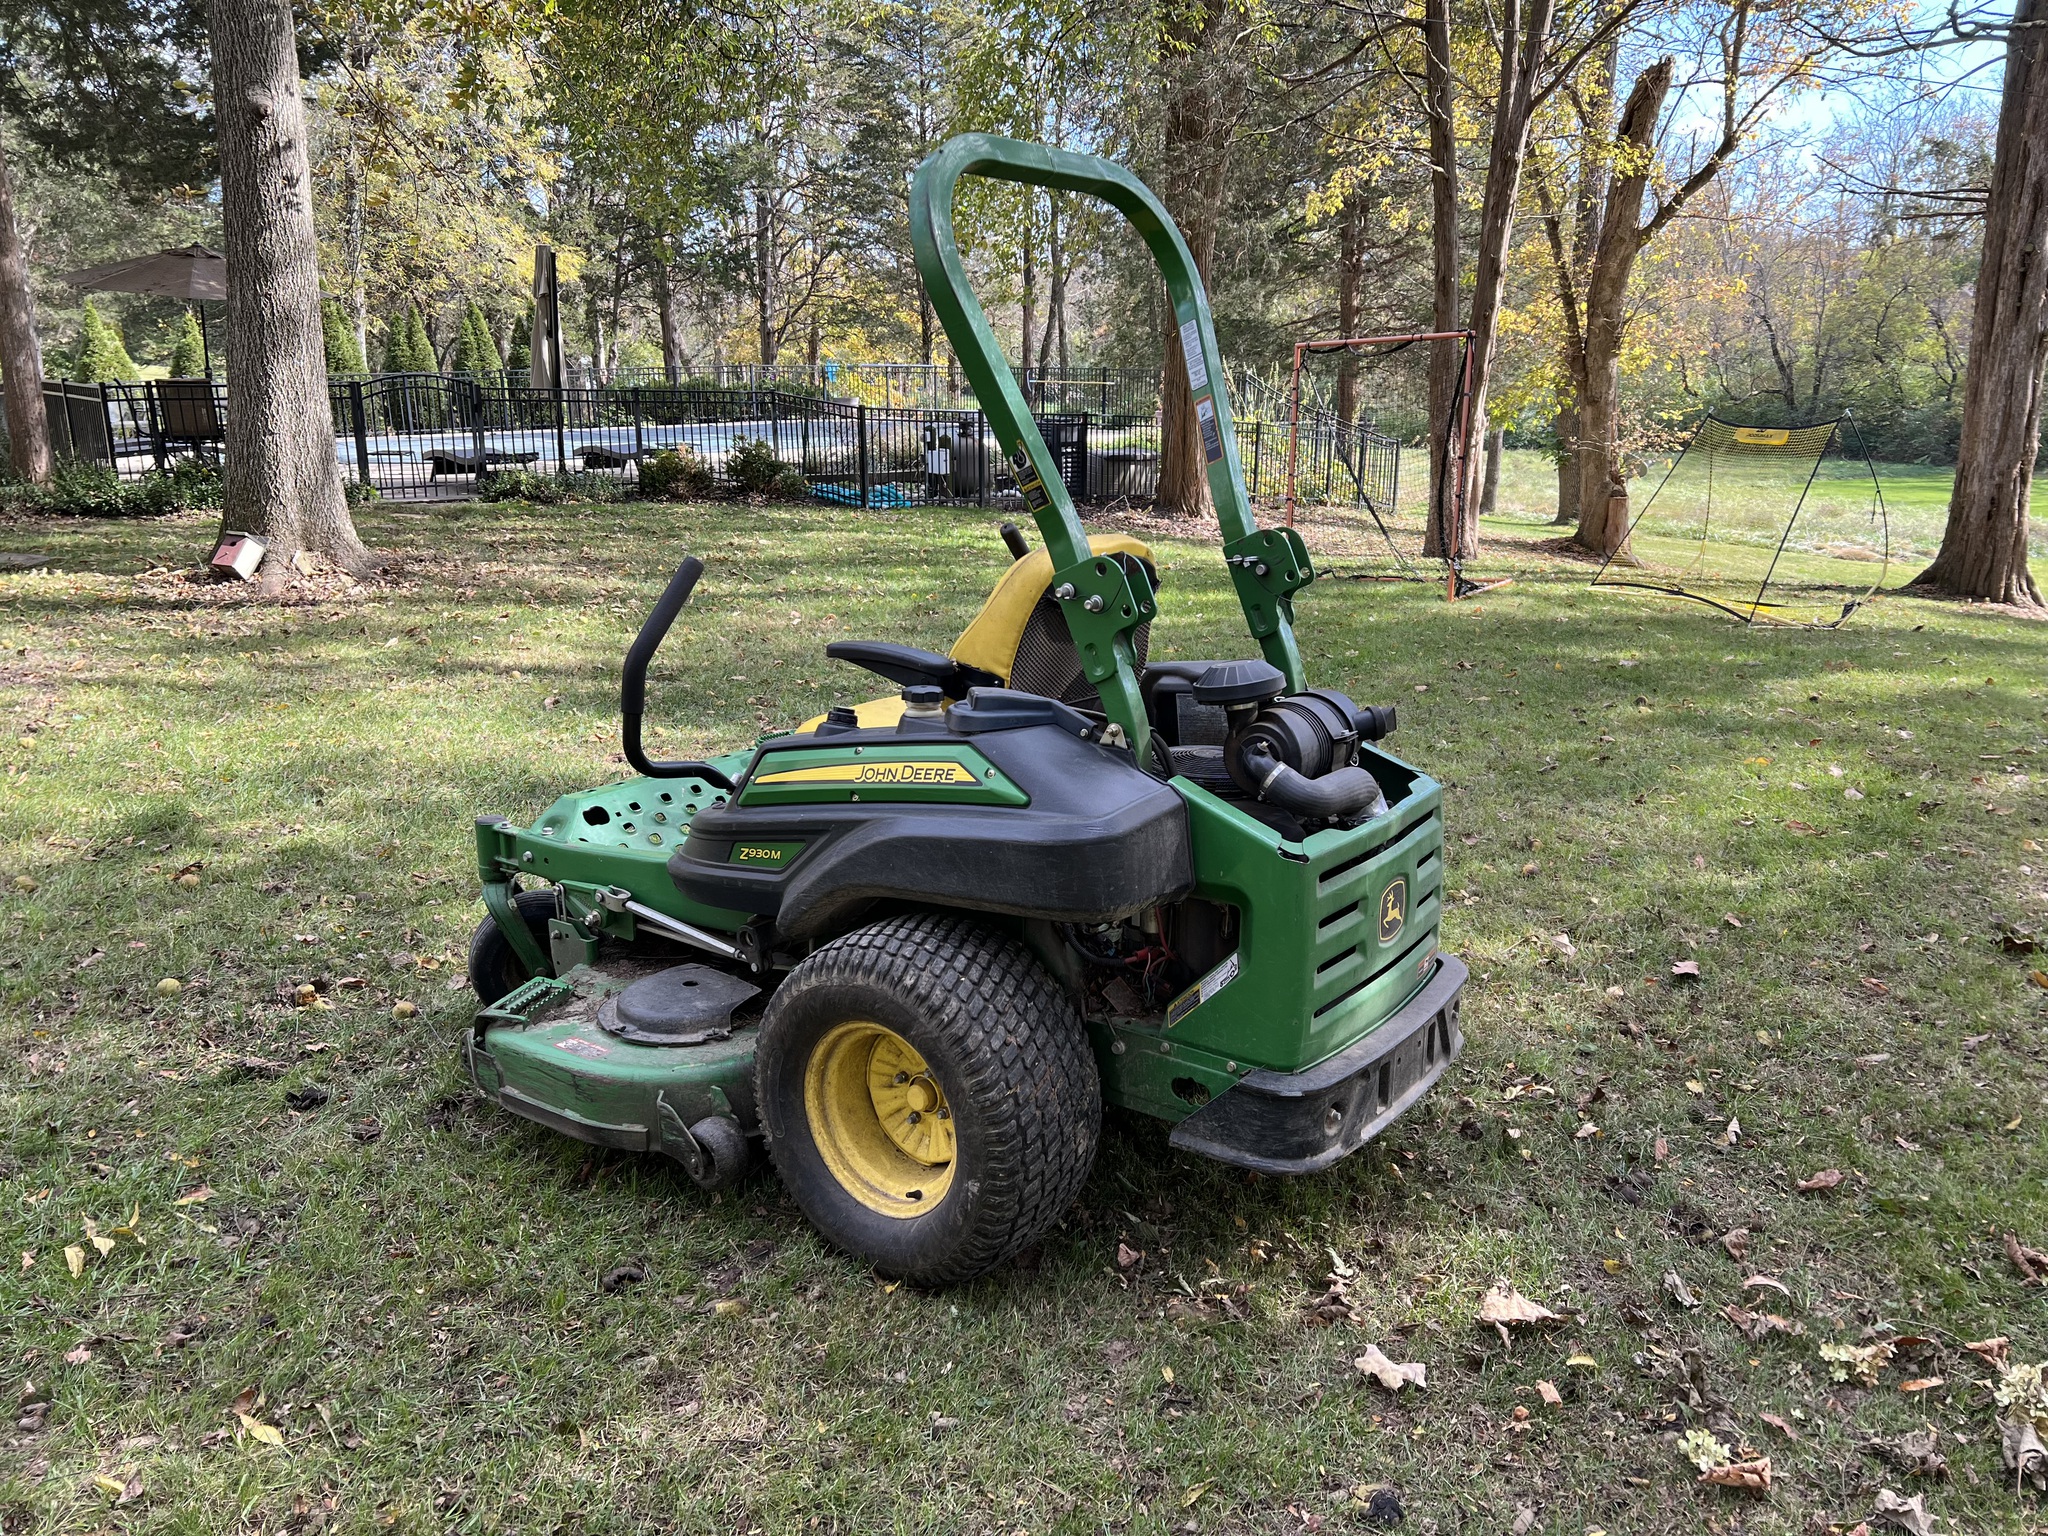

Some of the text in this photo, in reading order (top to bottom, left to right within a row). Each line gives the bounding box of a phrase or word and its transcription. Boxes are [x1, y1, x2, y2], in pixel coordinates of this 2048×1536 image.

[855, 765, 956, 781] JOHN DEERE
[739, 847, 781, 860] Z930M
